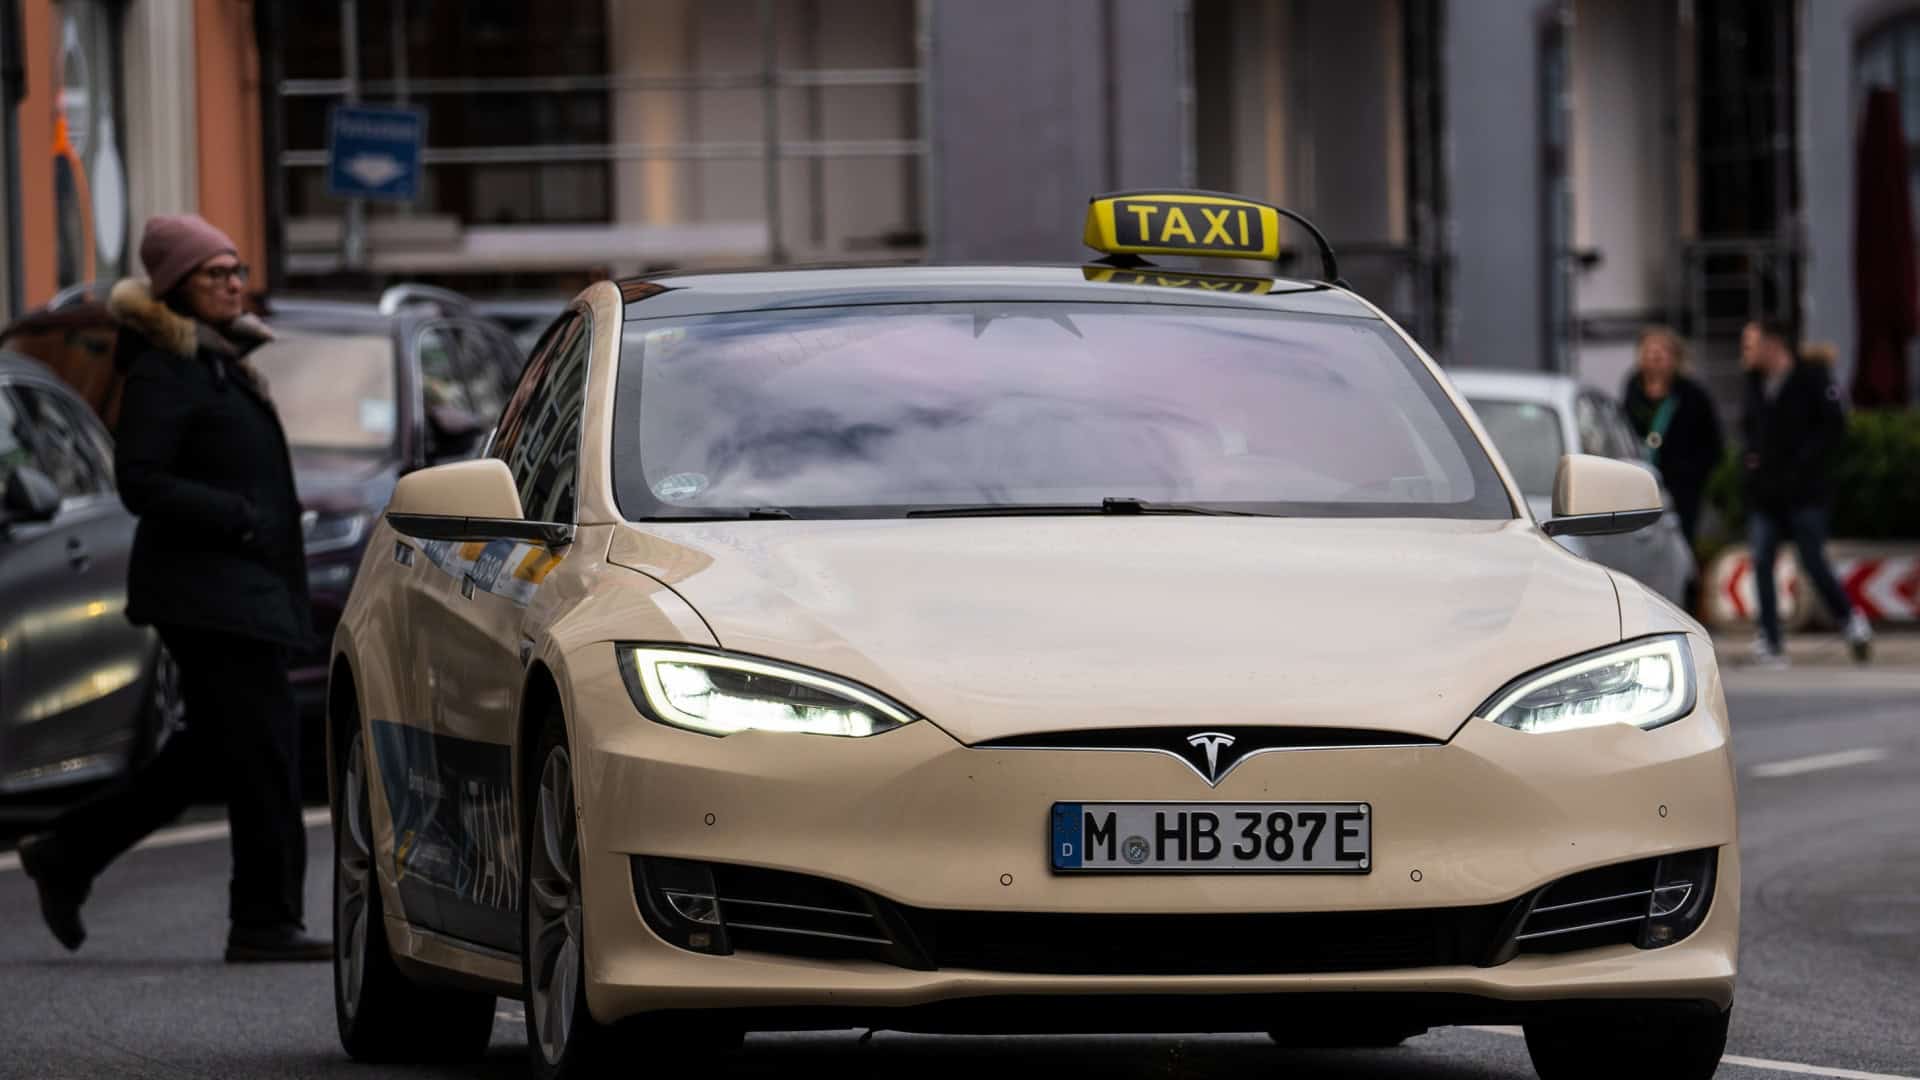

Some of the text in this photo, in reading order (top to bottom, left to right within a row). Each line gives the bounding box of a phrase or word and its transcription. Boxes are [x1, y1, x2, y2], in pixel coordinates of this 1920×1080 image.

[1127, 205, 1249, 246] TAXI
[1062, 843, 1073, 857] D
[1084, 812, 1117, 862] M
[1155, 812, 1222, 862] HB
